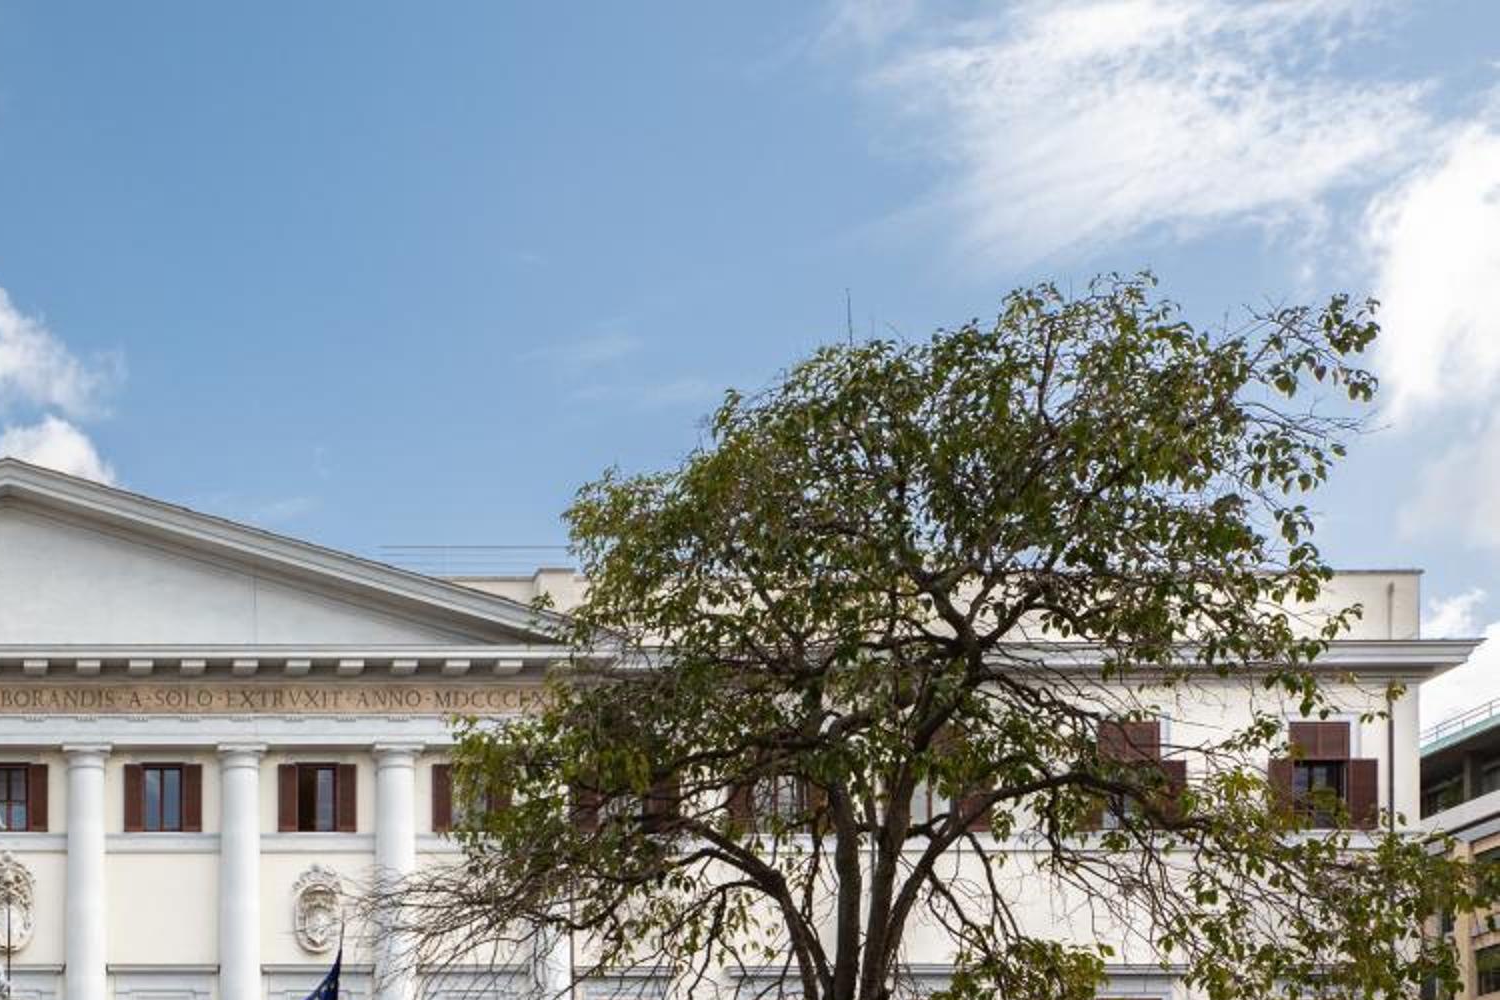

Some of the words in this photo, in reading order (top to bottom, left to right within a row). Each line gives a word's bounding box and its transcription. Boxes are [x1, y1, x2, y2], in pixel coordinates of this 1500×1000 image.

[129, 688, 142, 707] A
[154, 688, 213, 707] SOLO
[225, 688, 342, 707] EXTRVXIT
[357, 688, 422, 707] ANNO
